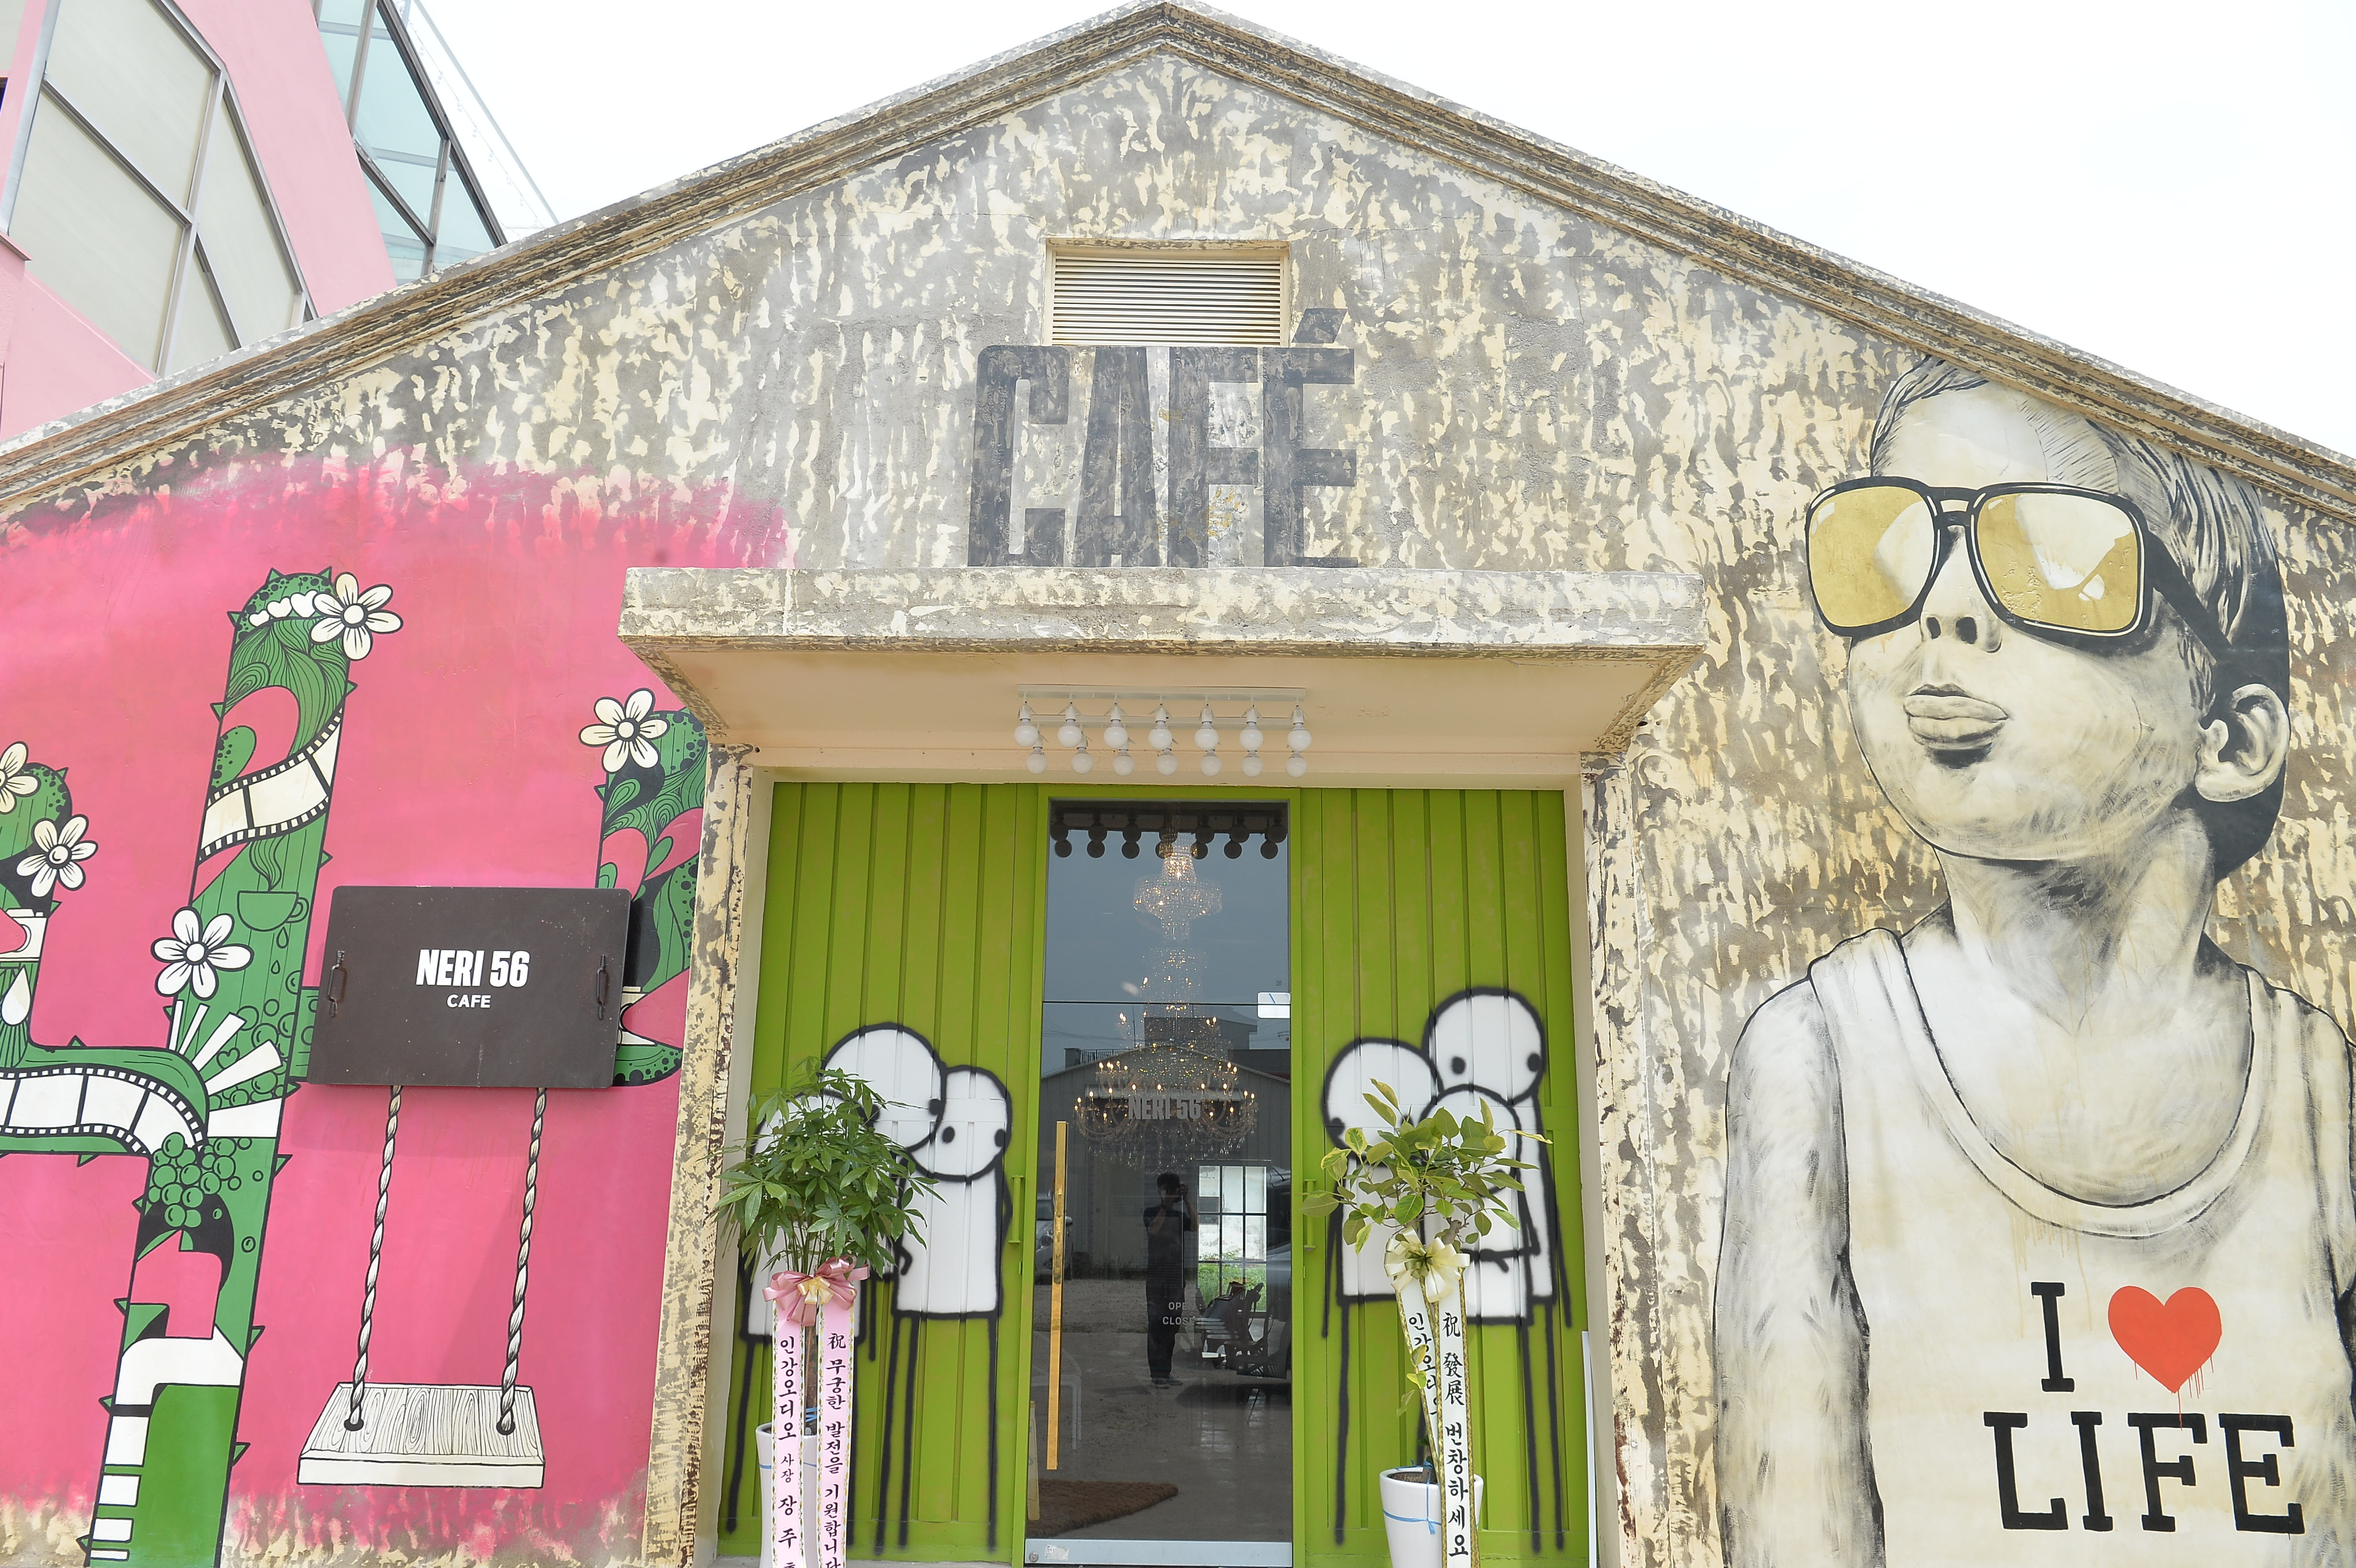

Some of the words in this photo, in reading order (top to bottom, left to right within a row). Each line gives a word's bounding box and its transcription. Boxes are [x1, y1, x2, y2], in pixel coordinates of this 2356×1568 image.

[968, 308, 1358, 567] CAFÉ
[416, 949, 485, 987] NERI
[489, 950, 531, 987] 56
[447, 994, 491, 1008] CAFE
[1128, 1097, 1170, 1119] NERI
[1177, 1097, 1201, 1119] 56
[827, 1333, 846, 1350] 祝
[1442, 1311, 1461, 1338] 祝
[2031, 1282, 2075, 1393] I
[778, 1336, 798, 1440] 인강오디오
[826, 1359, 846, 1410] 무궁한
[781, 1453, 795, 1483] 사장
[824, 1421, 845, 1474] 발전을
[1984, 1411, 2306, 1535] LIFE
[1445, 1422, 1469, 1557] 번창하세요
